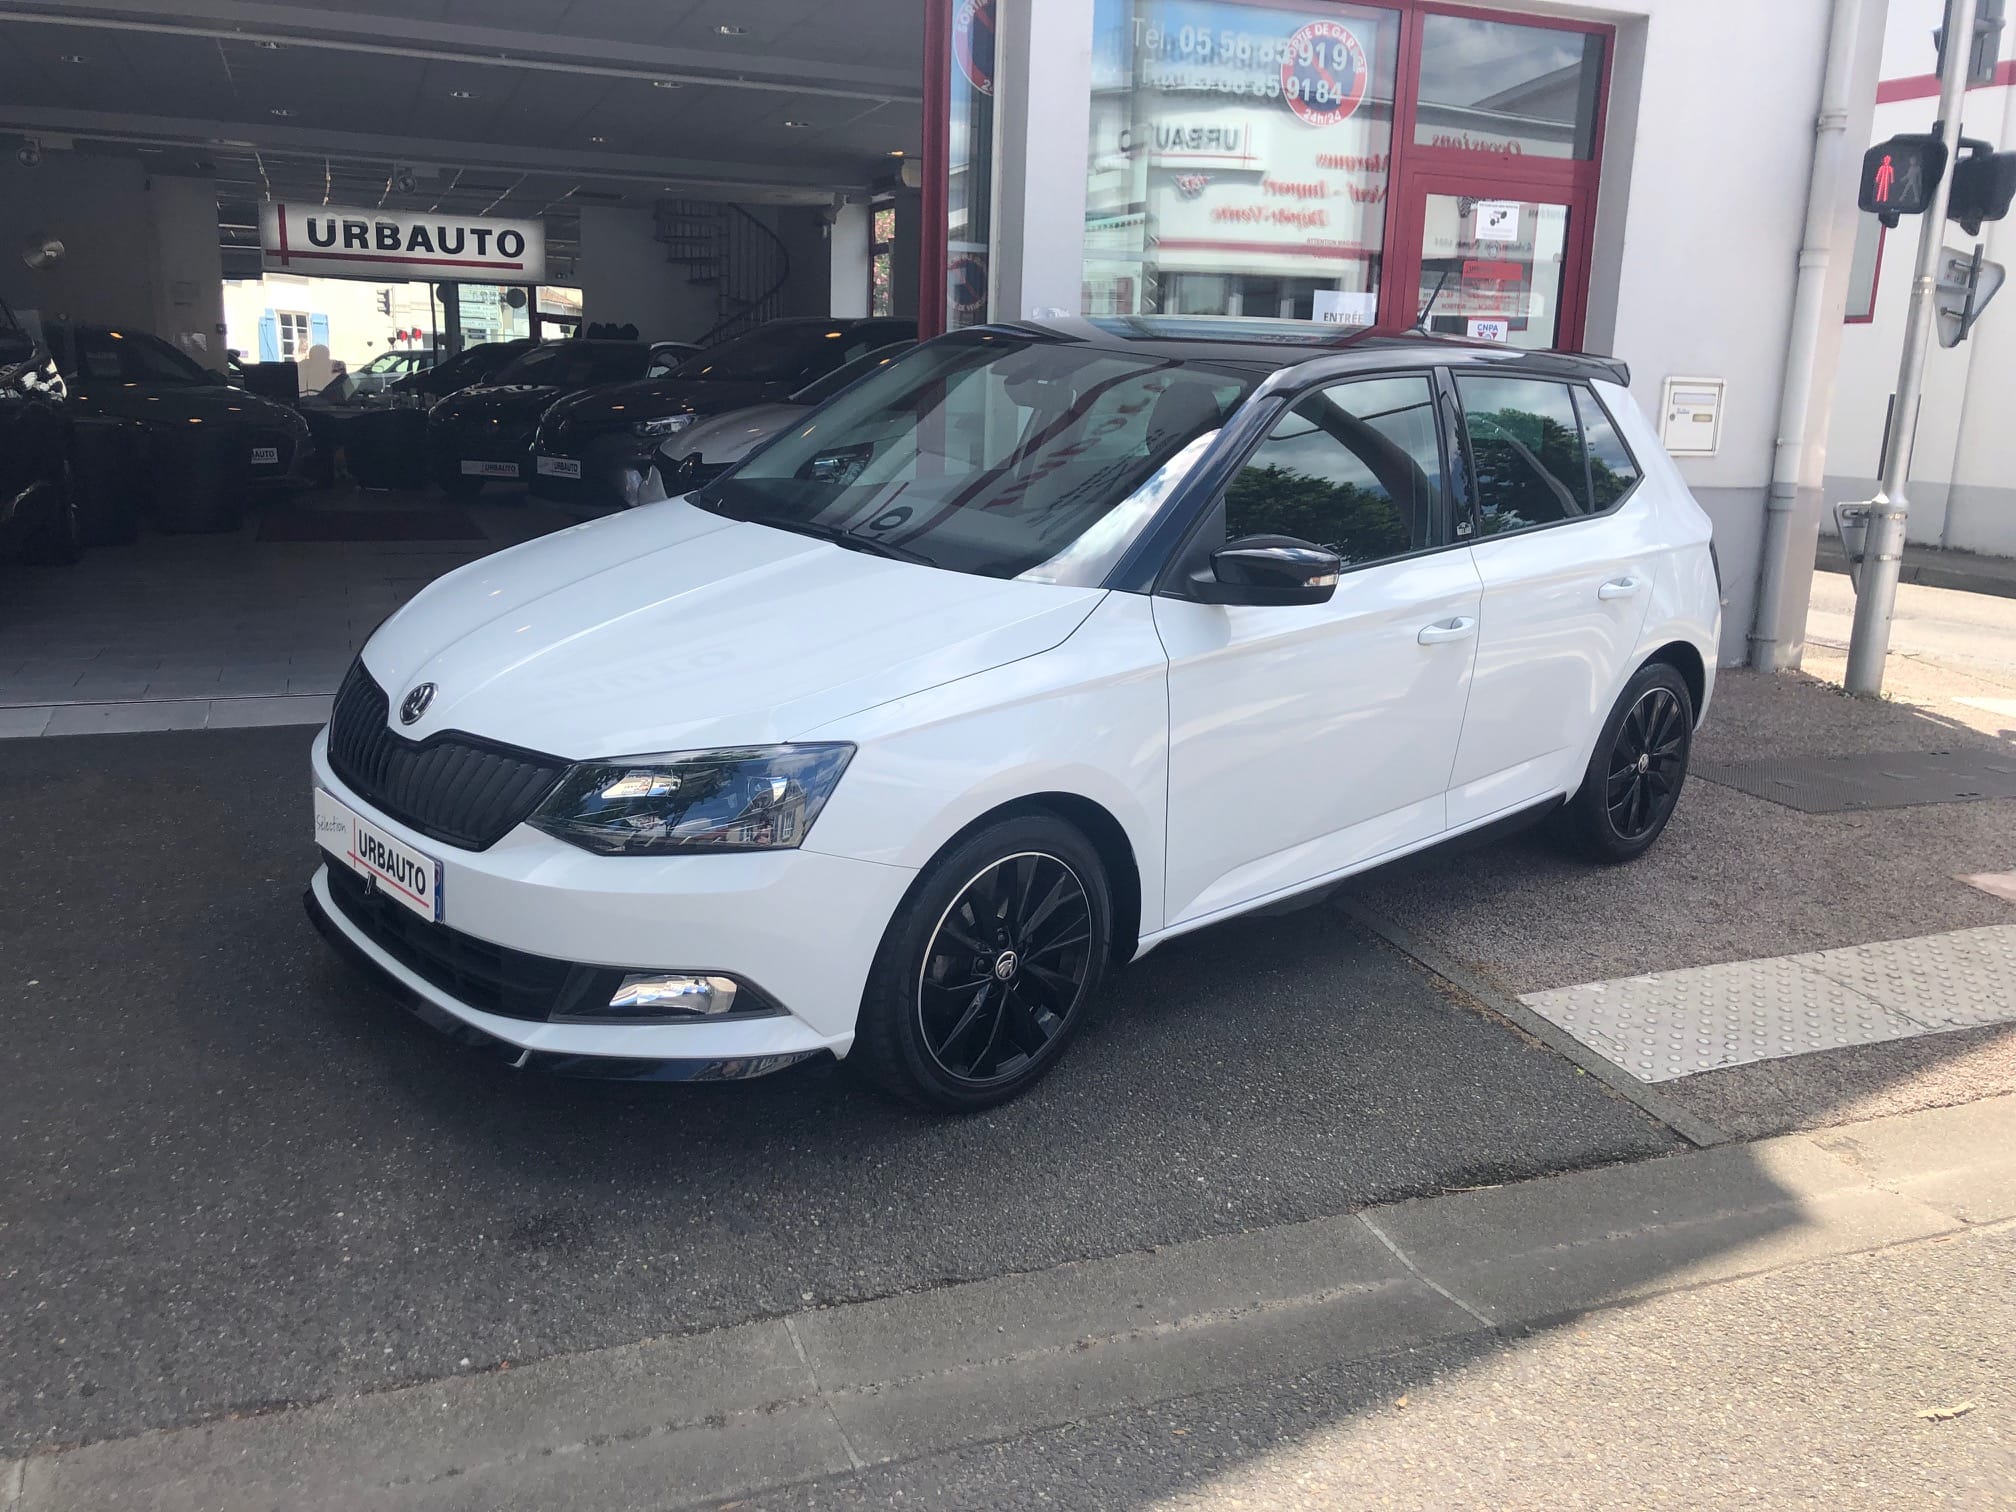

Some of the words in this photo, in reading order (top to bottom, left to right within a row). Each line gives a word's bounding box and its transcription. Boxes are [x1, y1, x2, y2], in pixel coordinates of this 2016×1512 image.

[1314, 22, 1330, 36] DE
[1179, 25, 1212, 55] 05
[1303, 109, 1342, 125] 24h/24
[307, 217, 525, 258] URBAUTO
[1323, 310, 1365, 324] ENTRÉE
[1477, 323, 1499, 333] CNPA
[358, 829, 427, 896] URBAUTO
